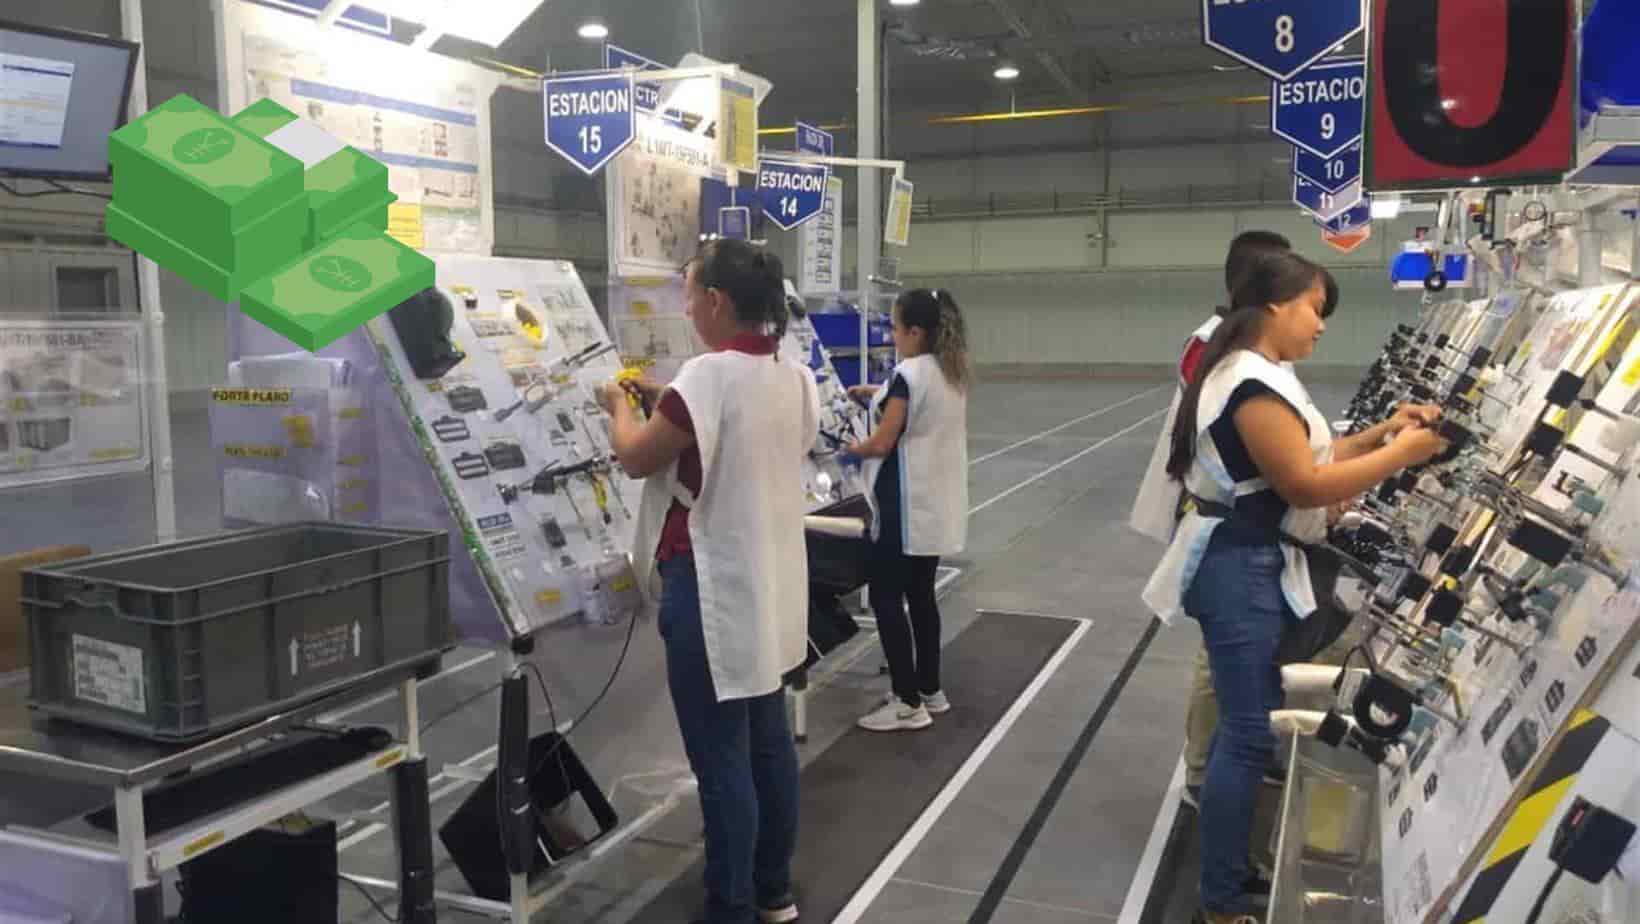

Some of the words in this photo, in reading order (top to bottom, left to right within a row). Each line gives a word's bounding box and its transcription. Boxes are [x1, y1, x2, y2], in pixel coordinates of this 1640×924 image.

[1275, 15, 1294, 52] 8
[549, 88, 629, 117] ESTACION
[636, 85, 658, 105] CTR
[1279, 76, 1364, 105] ESTACIO
[1320, 113, 1335, 139] 9
[578, 125, 602, 154] 15
[760, 170, 822, 192] ESTACION
[1323, 159, 1344, 180] 10
[780, 197, 798, 217] 14
[1319, 191, 1334, 209] 11
